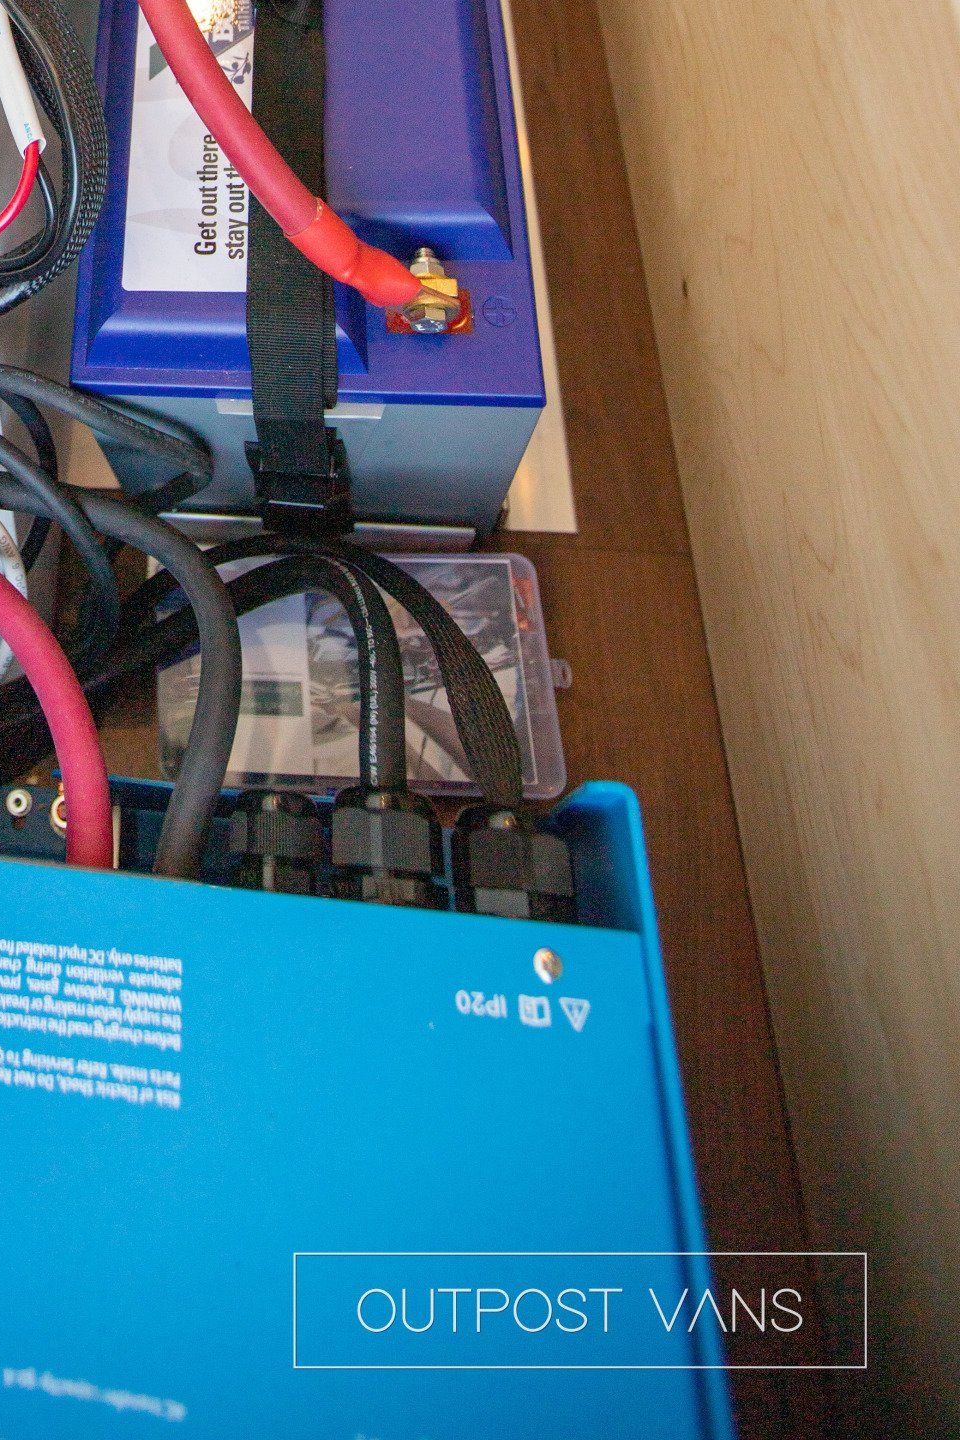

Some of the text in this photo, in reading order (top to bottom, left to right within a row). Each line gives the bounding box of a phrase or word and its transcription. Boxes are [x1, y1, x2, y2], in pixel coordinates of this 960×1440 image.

[194, 134, 218, 256] Get out there
[225, 182, 245, 213] out
[225, 217, 248, 260] stay
[16, 941, 57, 956] isolated
[59, 944, 87, 960] input
[89, 950, 104, 965] DC
[26, 957, 61, 977] during
[66, 965, 123, 982] ventilation
[134, 954, 181, 974] batteries
[129, 972, 181, 991] adequate
[64, 982, 114, 1003] Explosive
[31, 998, 42, 1011] or
[44, 996, 85, 1017] making
[87, 1004, 122, 1021] before
[455, 990, 507, 1018] IP20
[123, 1006, 161, 1026] supply
[162, 1014, 181, 1031] the
[48, 1019, 66, 1036] the
[68, 1021, 92, 1037] read
[94, 1021, 142, 1044] charging
[144, 1029, 180, 1051] Before
[7, 1050, 20, 1067] To
[23, 1049, 74, 1073] Servicing
[77, 1059, 107, 1078] Refer
[14, 1070, 35, 1088] Not
[38, 1073, 54, 1091] Do
[96, 1081, 138, 1103] Electric
[139, 1088, 153, 1105] of
